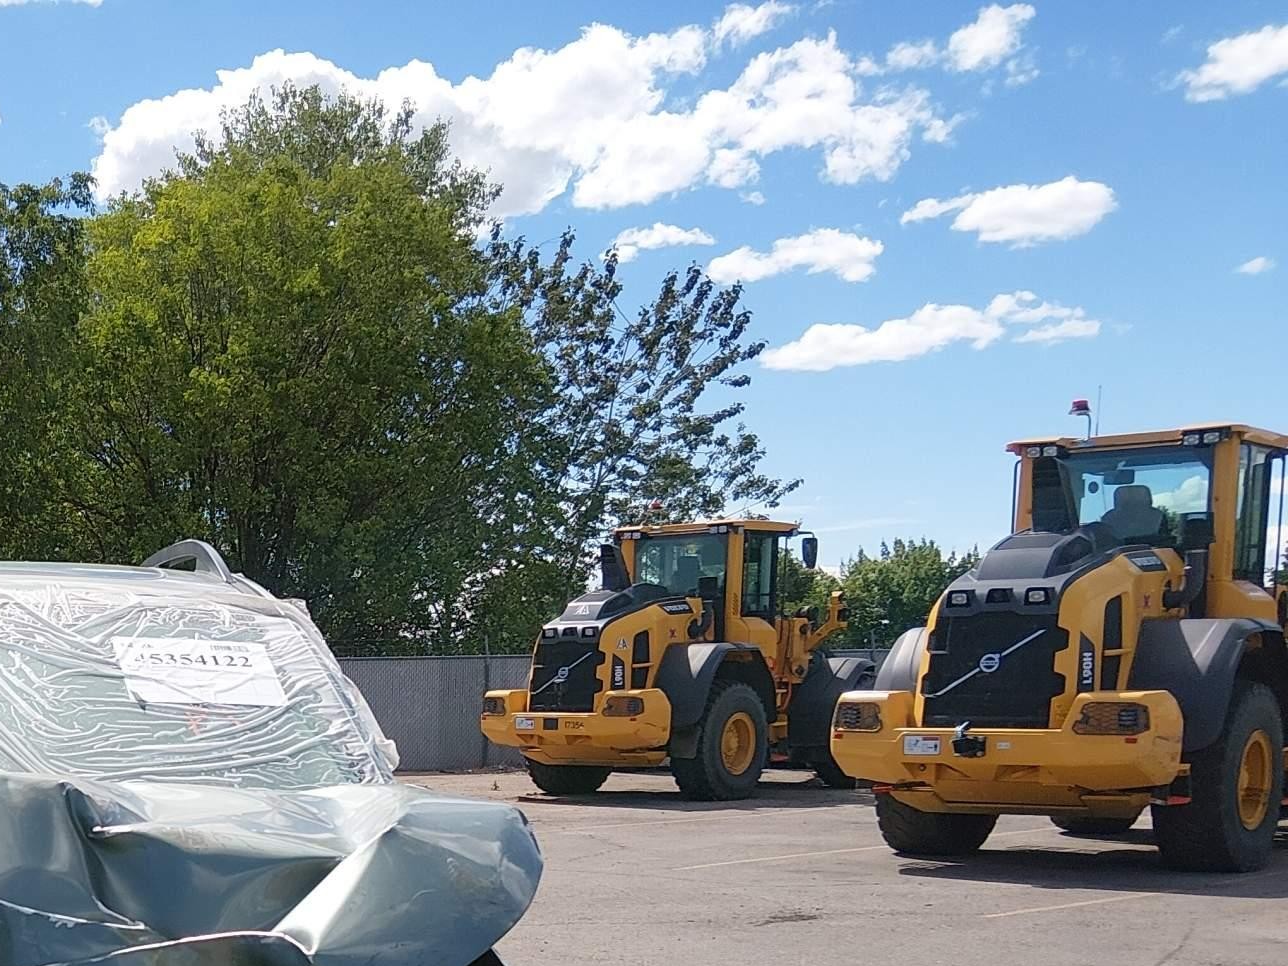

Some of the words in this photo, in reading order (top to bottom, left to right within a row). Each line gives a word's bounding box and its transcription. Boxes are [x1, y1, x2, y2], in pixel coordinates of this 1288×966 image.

[134, 652, 253, 668] 45354122
[1082, 652, 1093, 685] L90H
[614, 665, 624, 686] L90H
